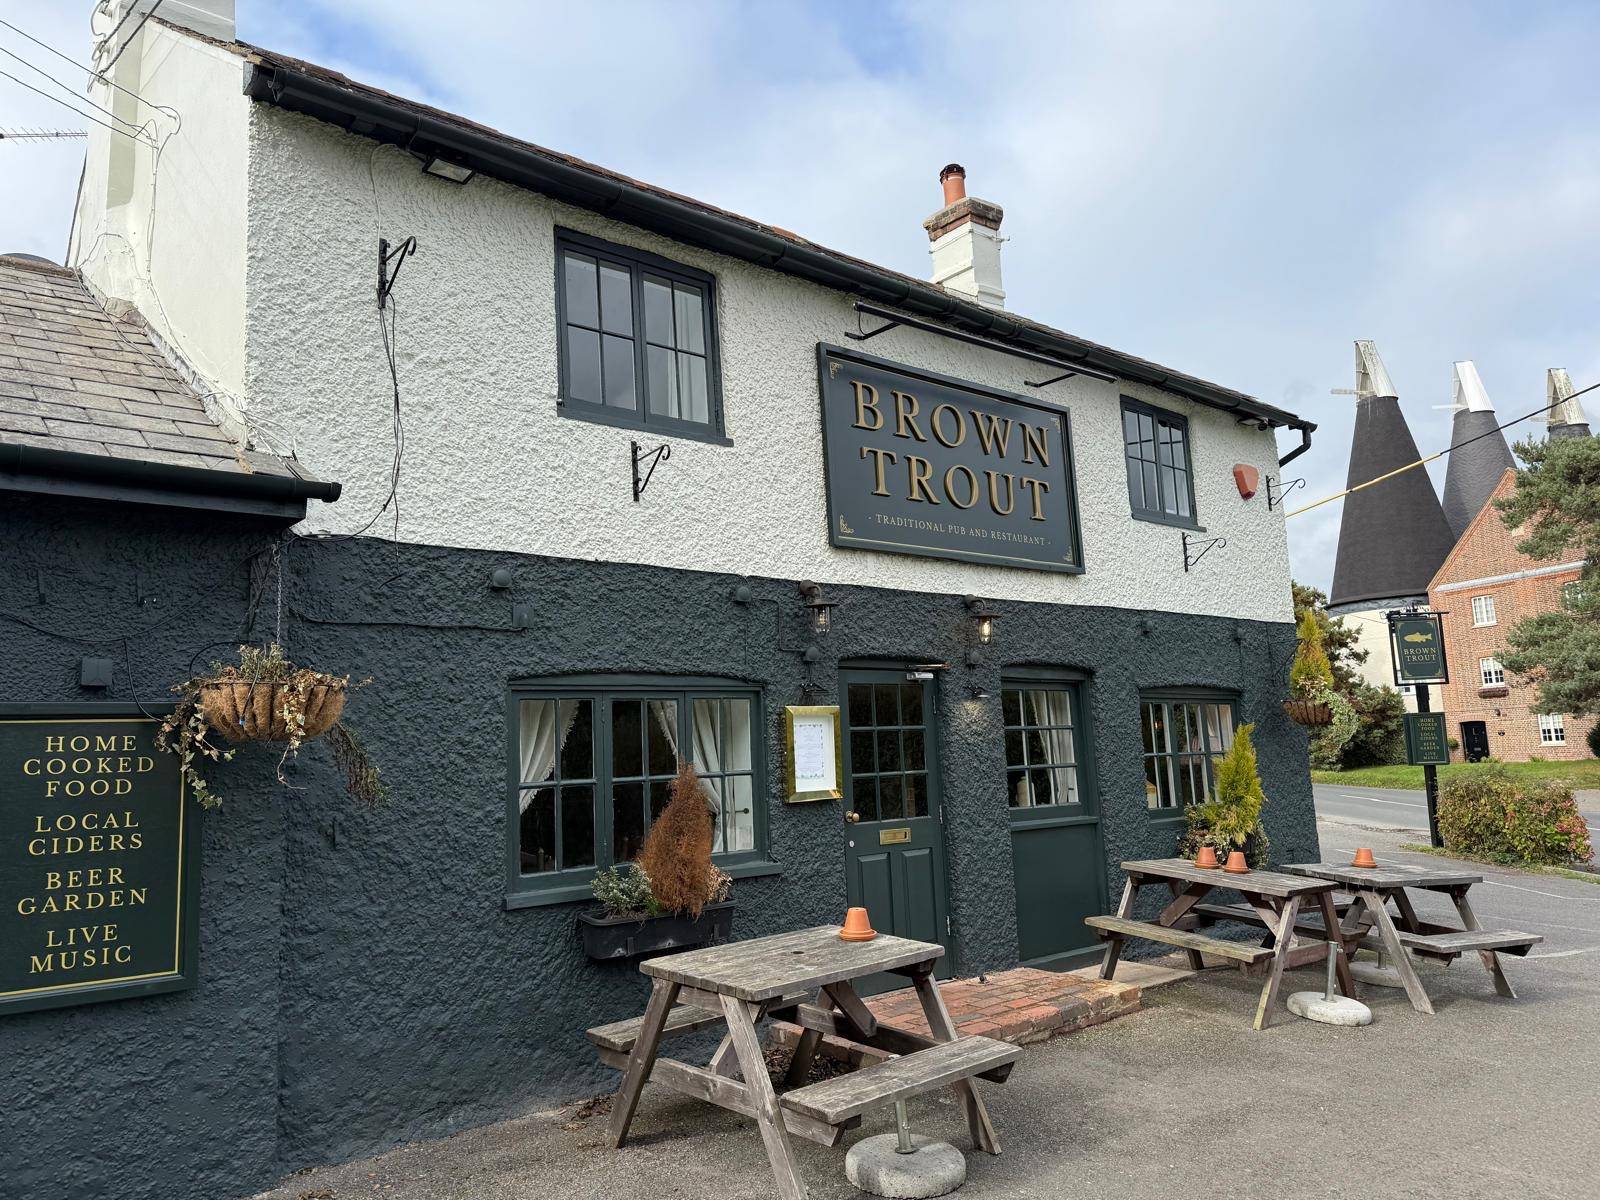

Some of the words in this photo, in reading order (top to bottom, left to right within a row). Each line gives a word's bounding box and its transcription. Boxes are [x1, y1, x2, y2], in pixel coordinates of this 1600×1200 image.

[850, 380, 1049, 467] BROWN
[860, 446, 1050, 521] TROUT
[876, 513, 946, 533] TRADITIONAL
[948, 525, 966, 535] PUB
[969, 528, 988, 538] AND
[991, 530, 1046, 546] RESTAURANT
[1404, 647, 1436, 655] BROWN
[1405, 654, 1436, 662] TROUT
[45, 735, 137, 753] HOME
[23, 756, 154, 776] COOKED
[45, 779, 132, 798] FOOD
[35, 811, 139, 833] LOCAL
[28, 833, 143, 856] CIDERS
[45, 867, 125, 890] BEER
[17, 888, 148, 915] GARDEN
[47, 924, 118, 947] LIVE
[30, 945, 132, 974] MUSIC
